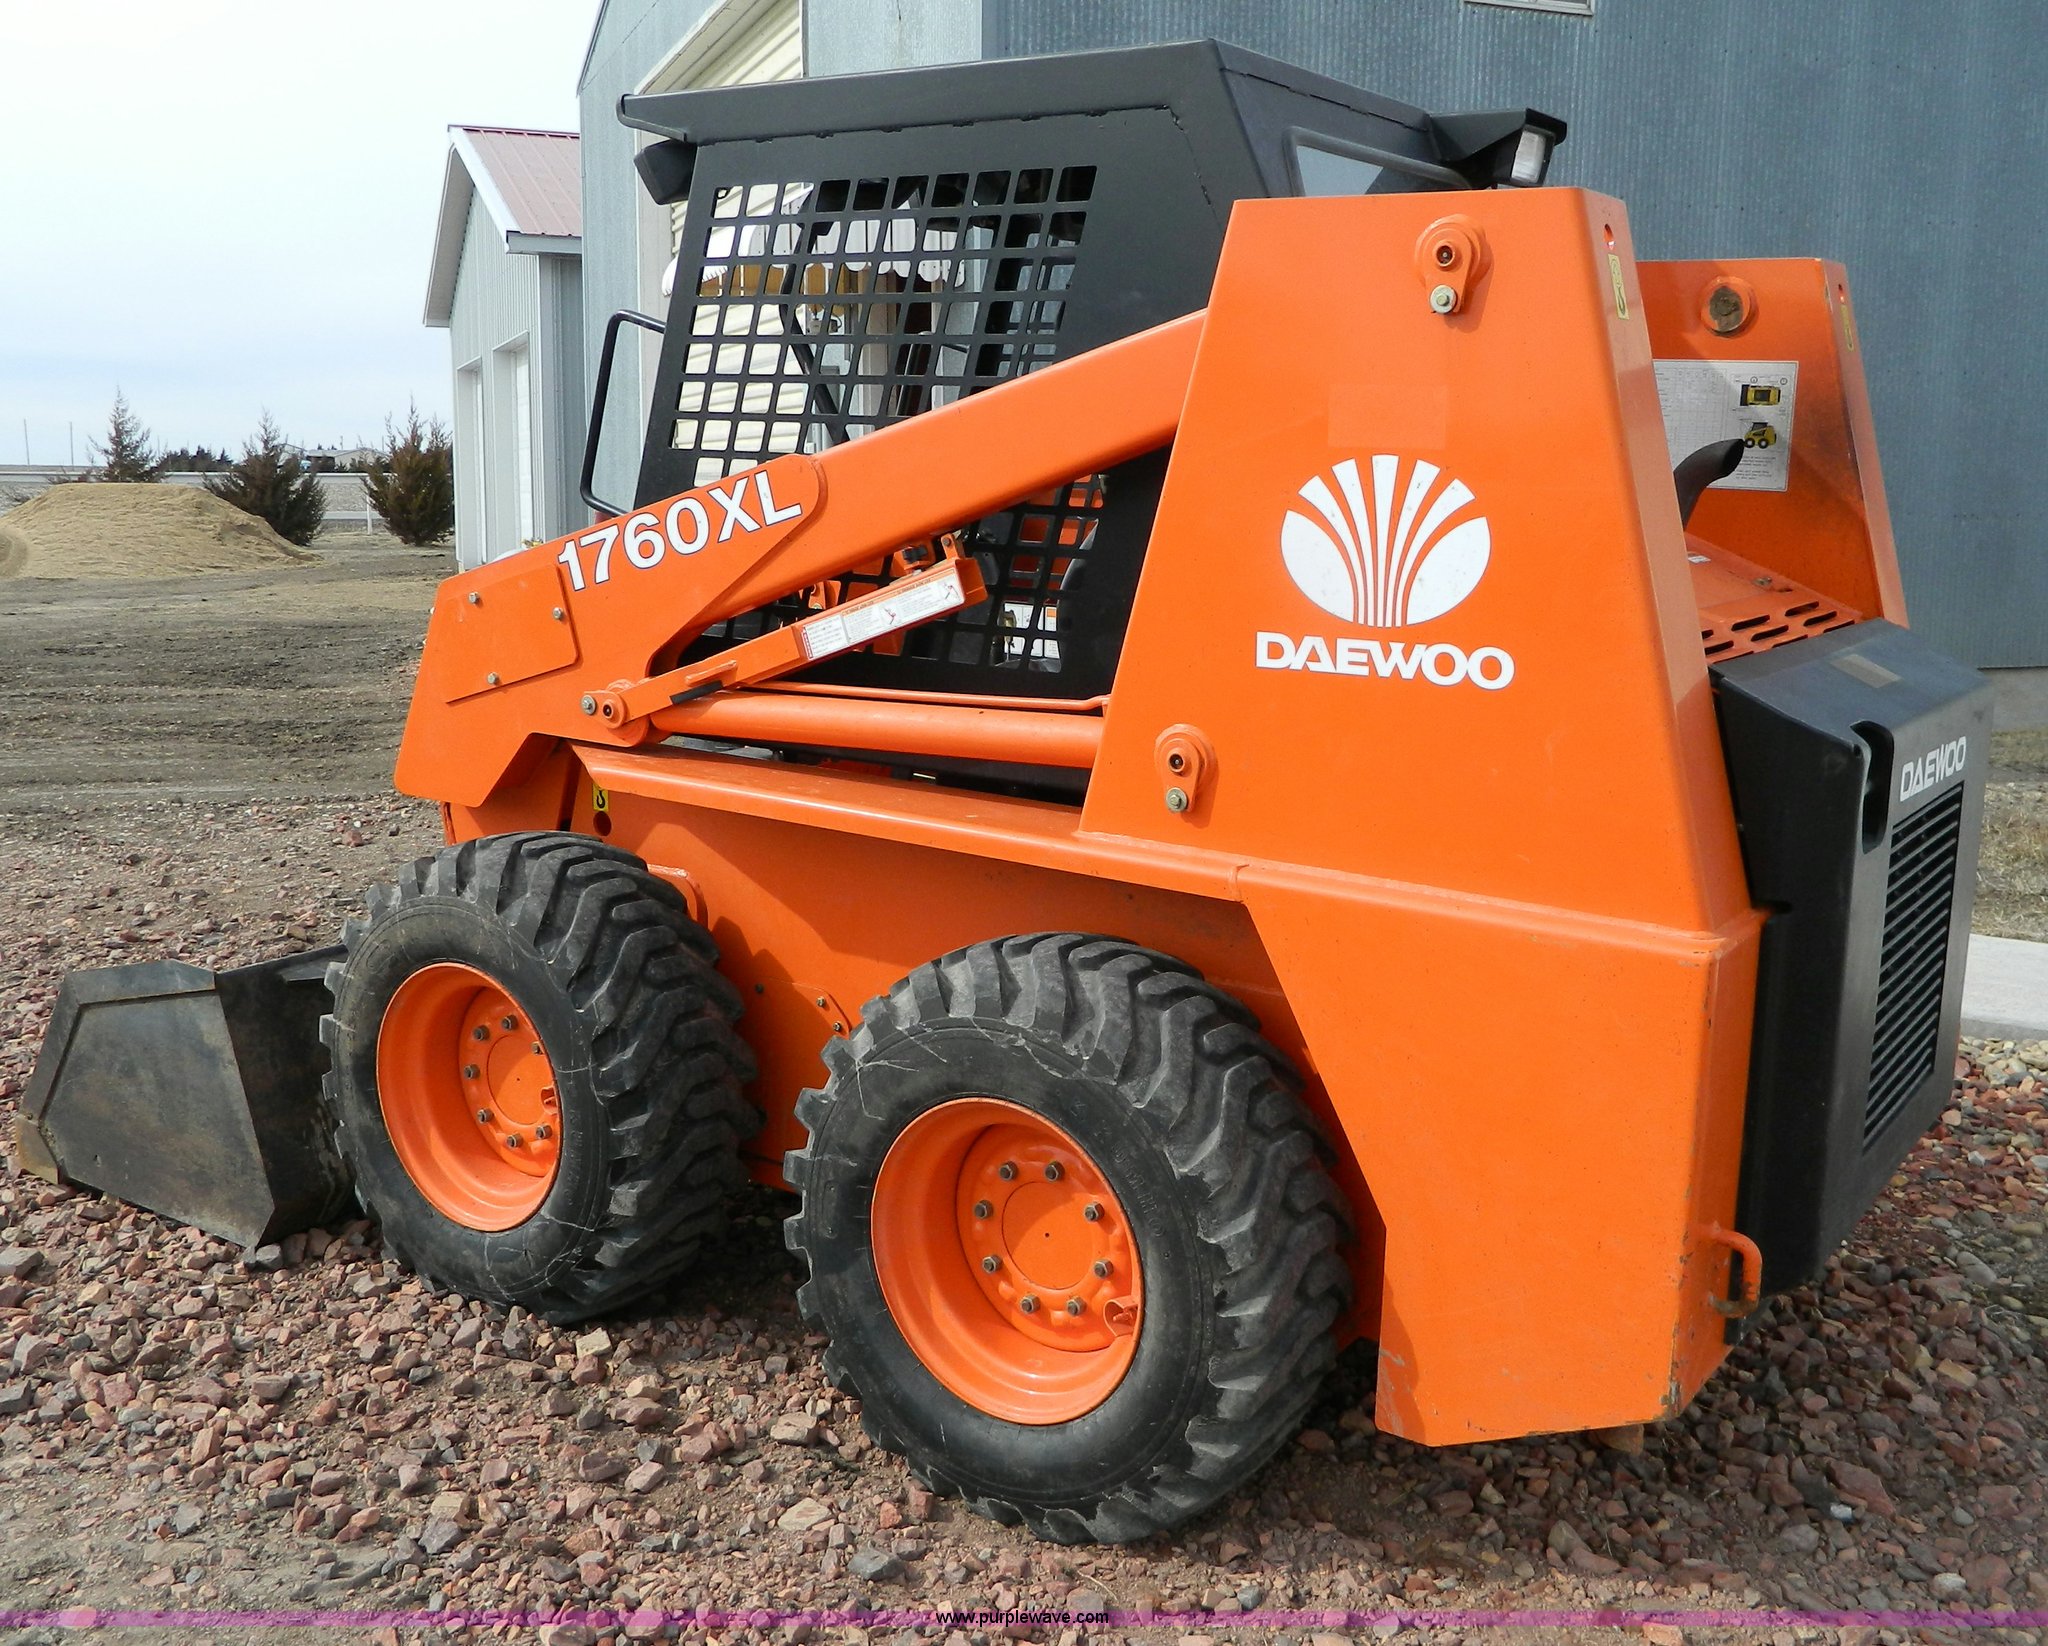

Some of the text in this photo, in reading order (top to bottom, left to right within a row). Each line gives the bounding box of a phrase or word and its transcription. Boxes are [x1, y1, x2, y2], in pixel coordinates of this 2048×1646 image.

[558, 470, 803, 591] 1760XL
[1256, 631, 1515, 690] DAEWOO
[1899, 736, 1967, 802] DAEWOO
